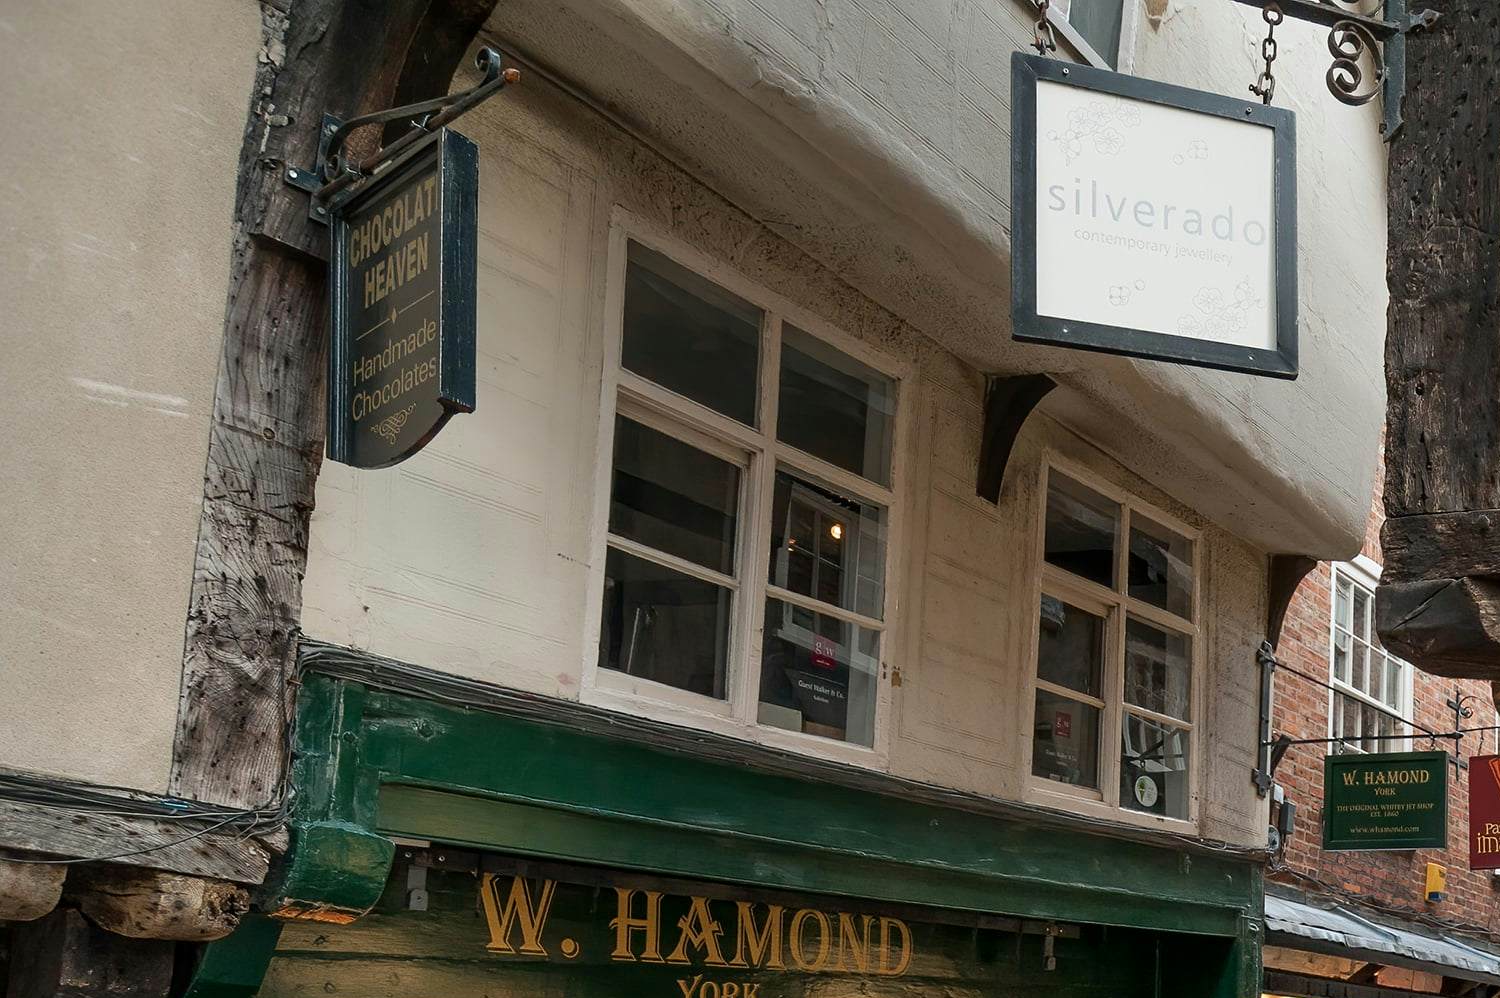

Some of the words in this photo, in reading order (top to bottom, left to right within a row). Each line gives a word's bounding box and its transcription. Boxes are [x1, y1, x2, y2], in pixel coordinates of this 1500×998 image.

[350, 176, 438, 267] CHOCOLAT
[1048, 177, 1266, 246] silverado
[364, 232, 429, 309] HEAVEN
[1074, 228, 1171, 257] contemporary
[1174, 243, 1233, 266] jewellery
[353, 320, 436, 386] Handmade
[352, 357, 437, 422] Chocolates
[1343, 769, 1360, 786] W.
[1364, 769, 1430, 785] HAMOND
[1349, 804, 1379, 812] ORIGINAL
[1380, 803, 1405, 811] WHITBY
[1406, 803, 1416, 811] JET
[1374, 787, 1396, 796] YORK
[1350, 825, 1420, 834] www.whamond.com
[480, 871, 580, 958] W.
[608, 886, 913, 977] HAMOND
